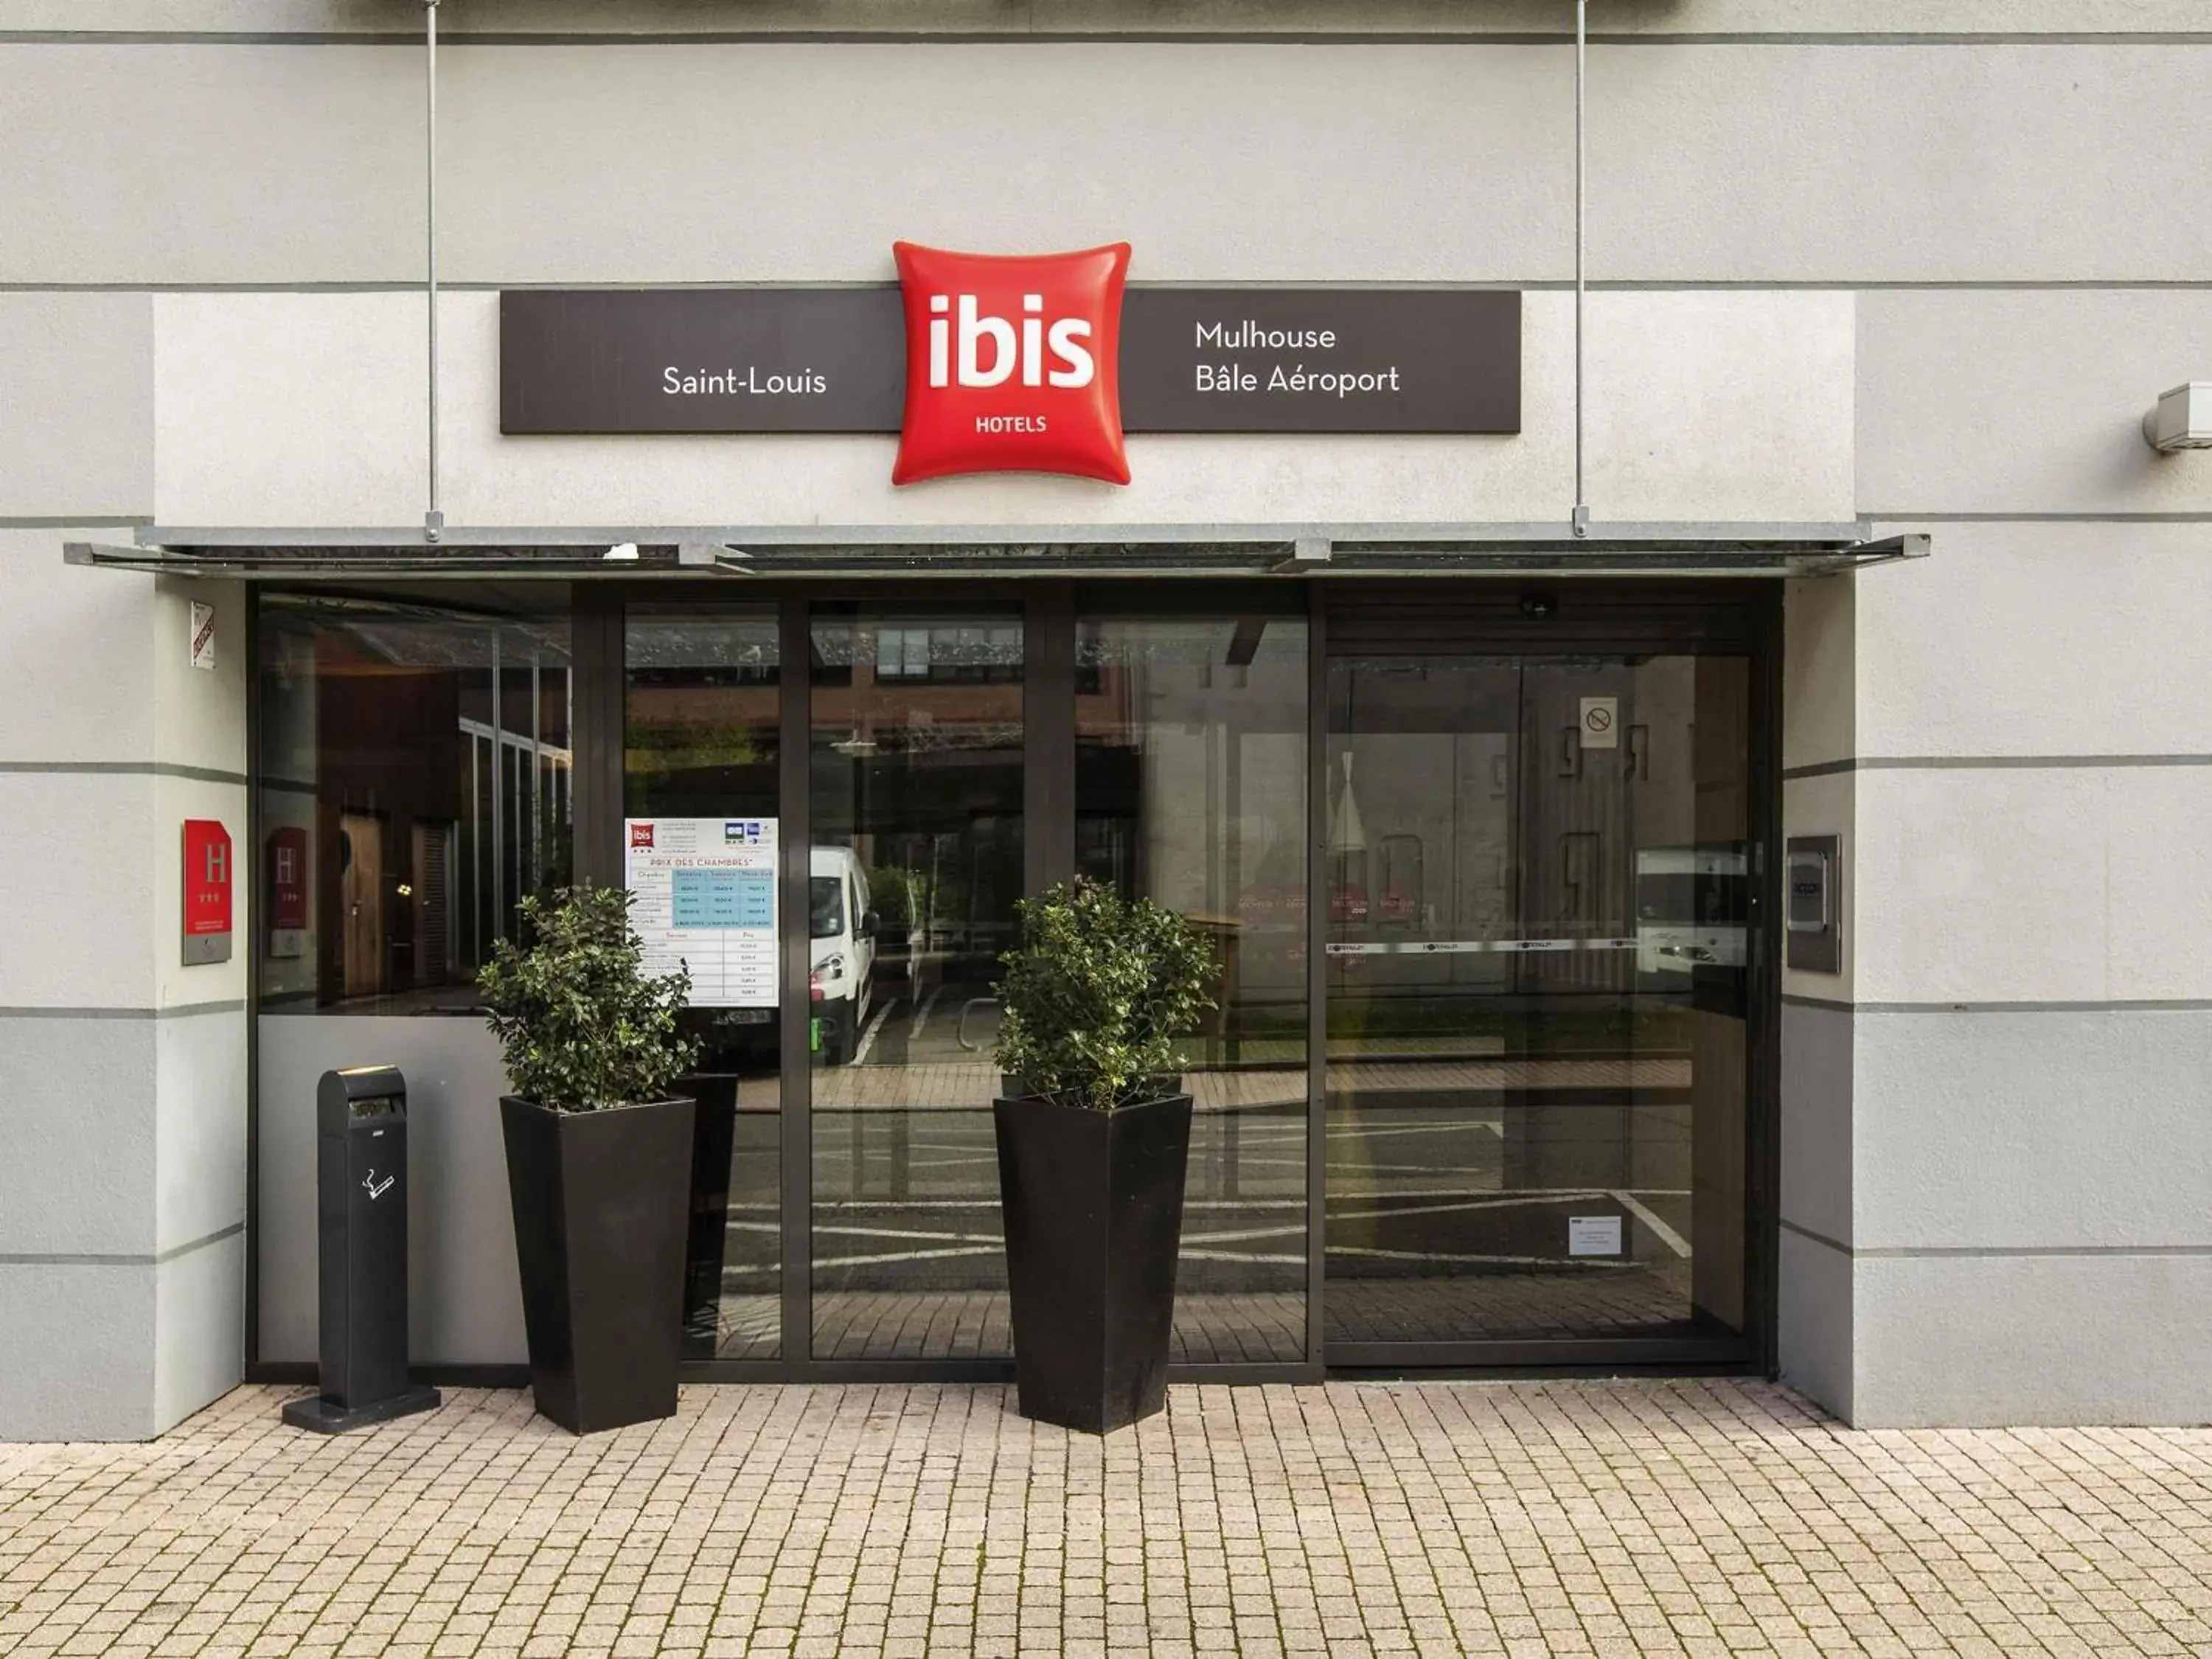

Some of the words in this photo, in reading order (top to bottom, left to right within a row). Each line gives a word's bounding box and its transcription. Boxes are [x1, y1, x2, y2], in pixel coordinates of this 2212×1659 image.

[930, 294, 1095, 389] ibis
[1196, 319, 1336, 348] Mulhouse
[663, 366, 827, 394] Saint-Louis
[1196, 363, 1257, 392] Bâle
[1267, 364, 1400, 398] Aéroport
[975, 416, 1047, 433] HOTELS
[634, 830, 651, 840] ibis
[206, 844, 226, 883] H
